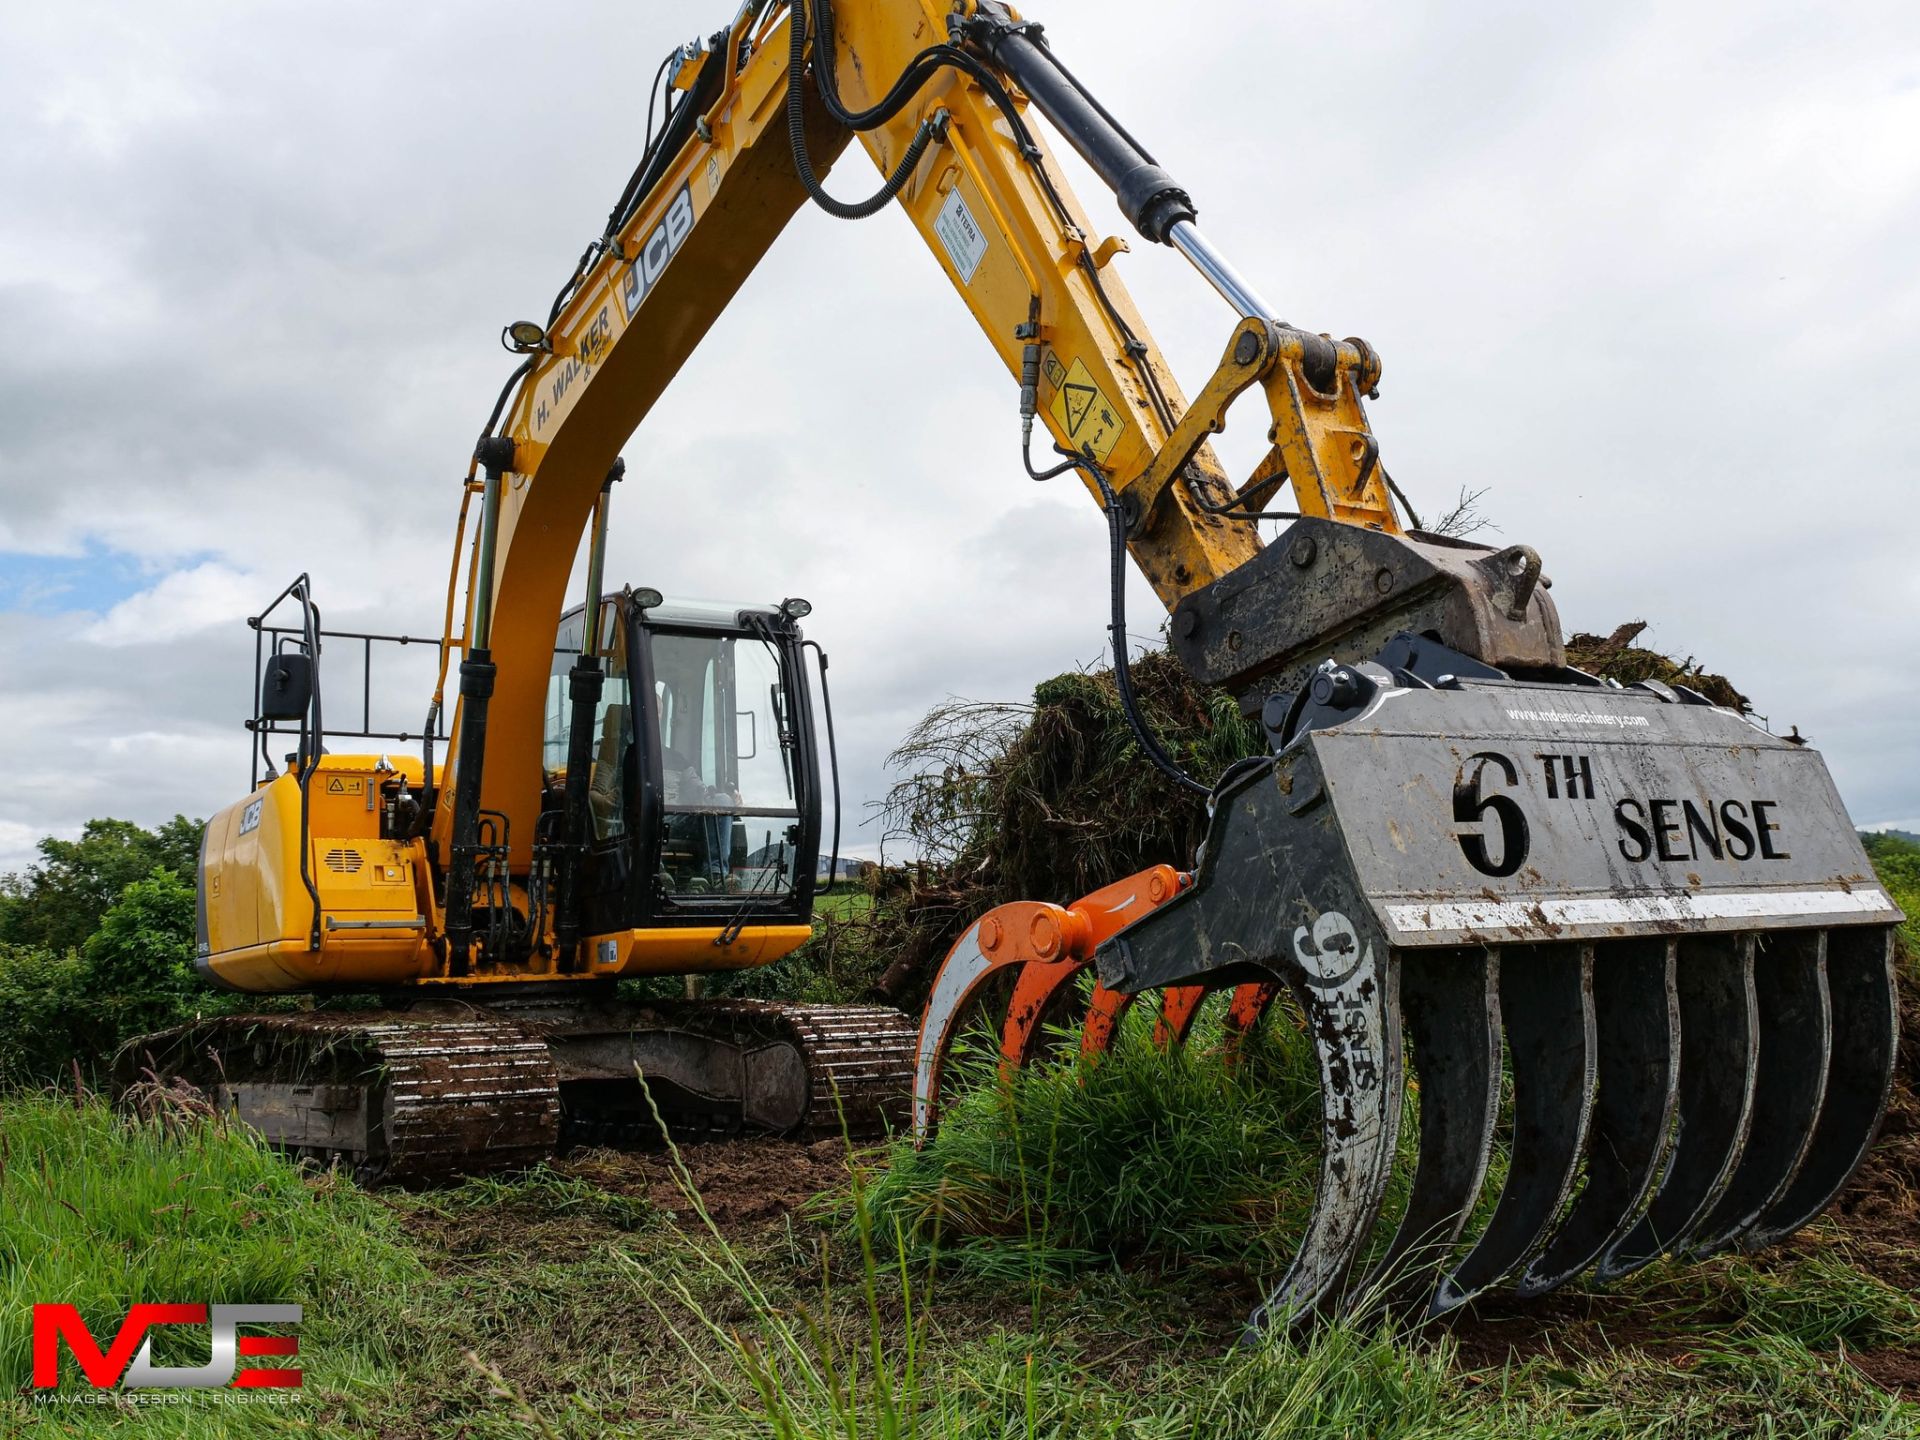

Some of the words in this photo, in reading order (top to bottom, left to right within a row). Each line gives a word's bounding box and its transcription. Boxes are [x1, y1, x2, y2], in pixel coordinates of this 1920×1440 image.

[628, 188, 692, 313] JCB
[961, 213, 976, 242] TEFRA
[537, 400, 550, 431] H.
[553, 305, 609, 406] WALKER
[1506, 708, 1650, 728] www.mdemachinery.com
[1614, 799, 1792, 862] SENSE
[1293, 911, 1360, 980] 6
[1344, 994, 1377, 1091] SENSE
